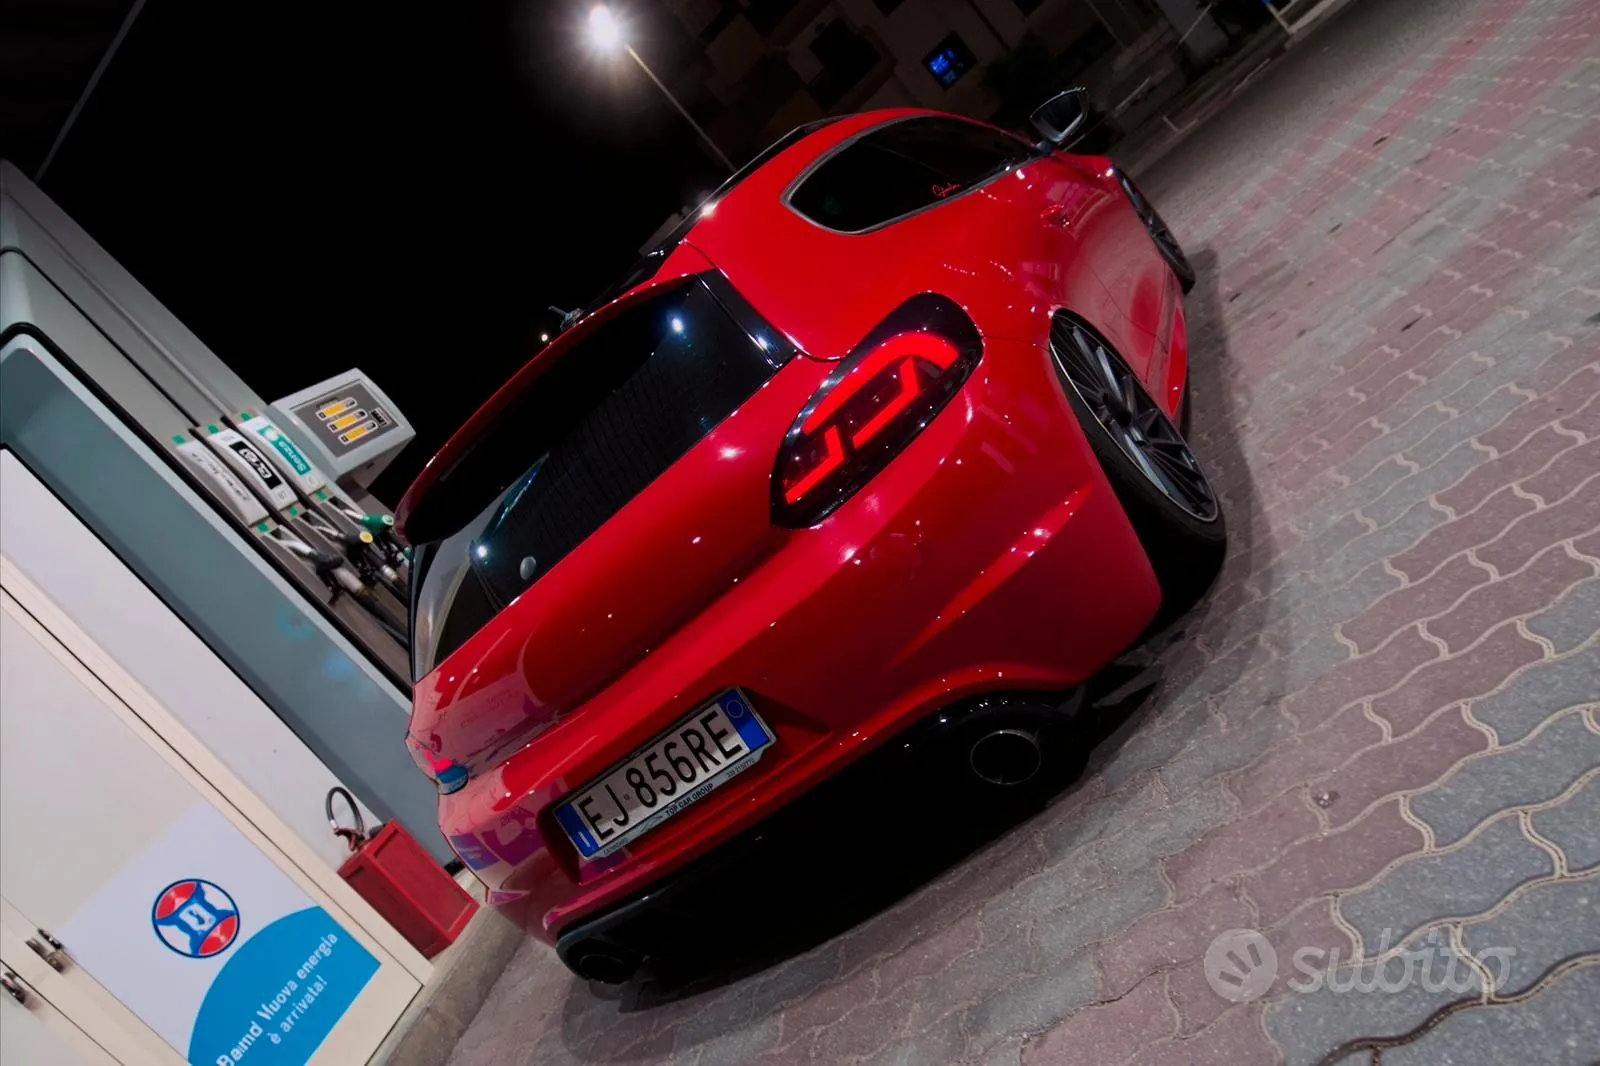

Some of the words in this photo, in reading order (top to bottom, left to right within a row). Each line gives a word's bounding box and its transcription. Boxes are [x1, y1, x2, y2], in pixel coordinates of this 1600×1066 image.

[664, 803, 679, 818] TOP
[678, 796, 694, 810] CAR
[692, 782, 715, 803] GROUP
[296, 933, 338, 980] energia
[266, 1032, 282, 1045] è
[280, 974, 328, 1033] arrivata!
